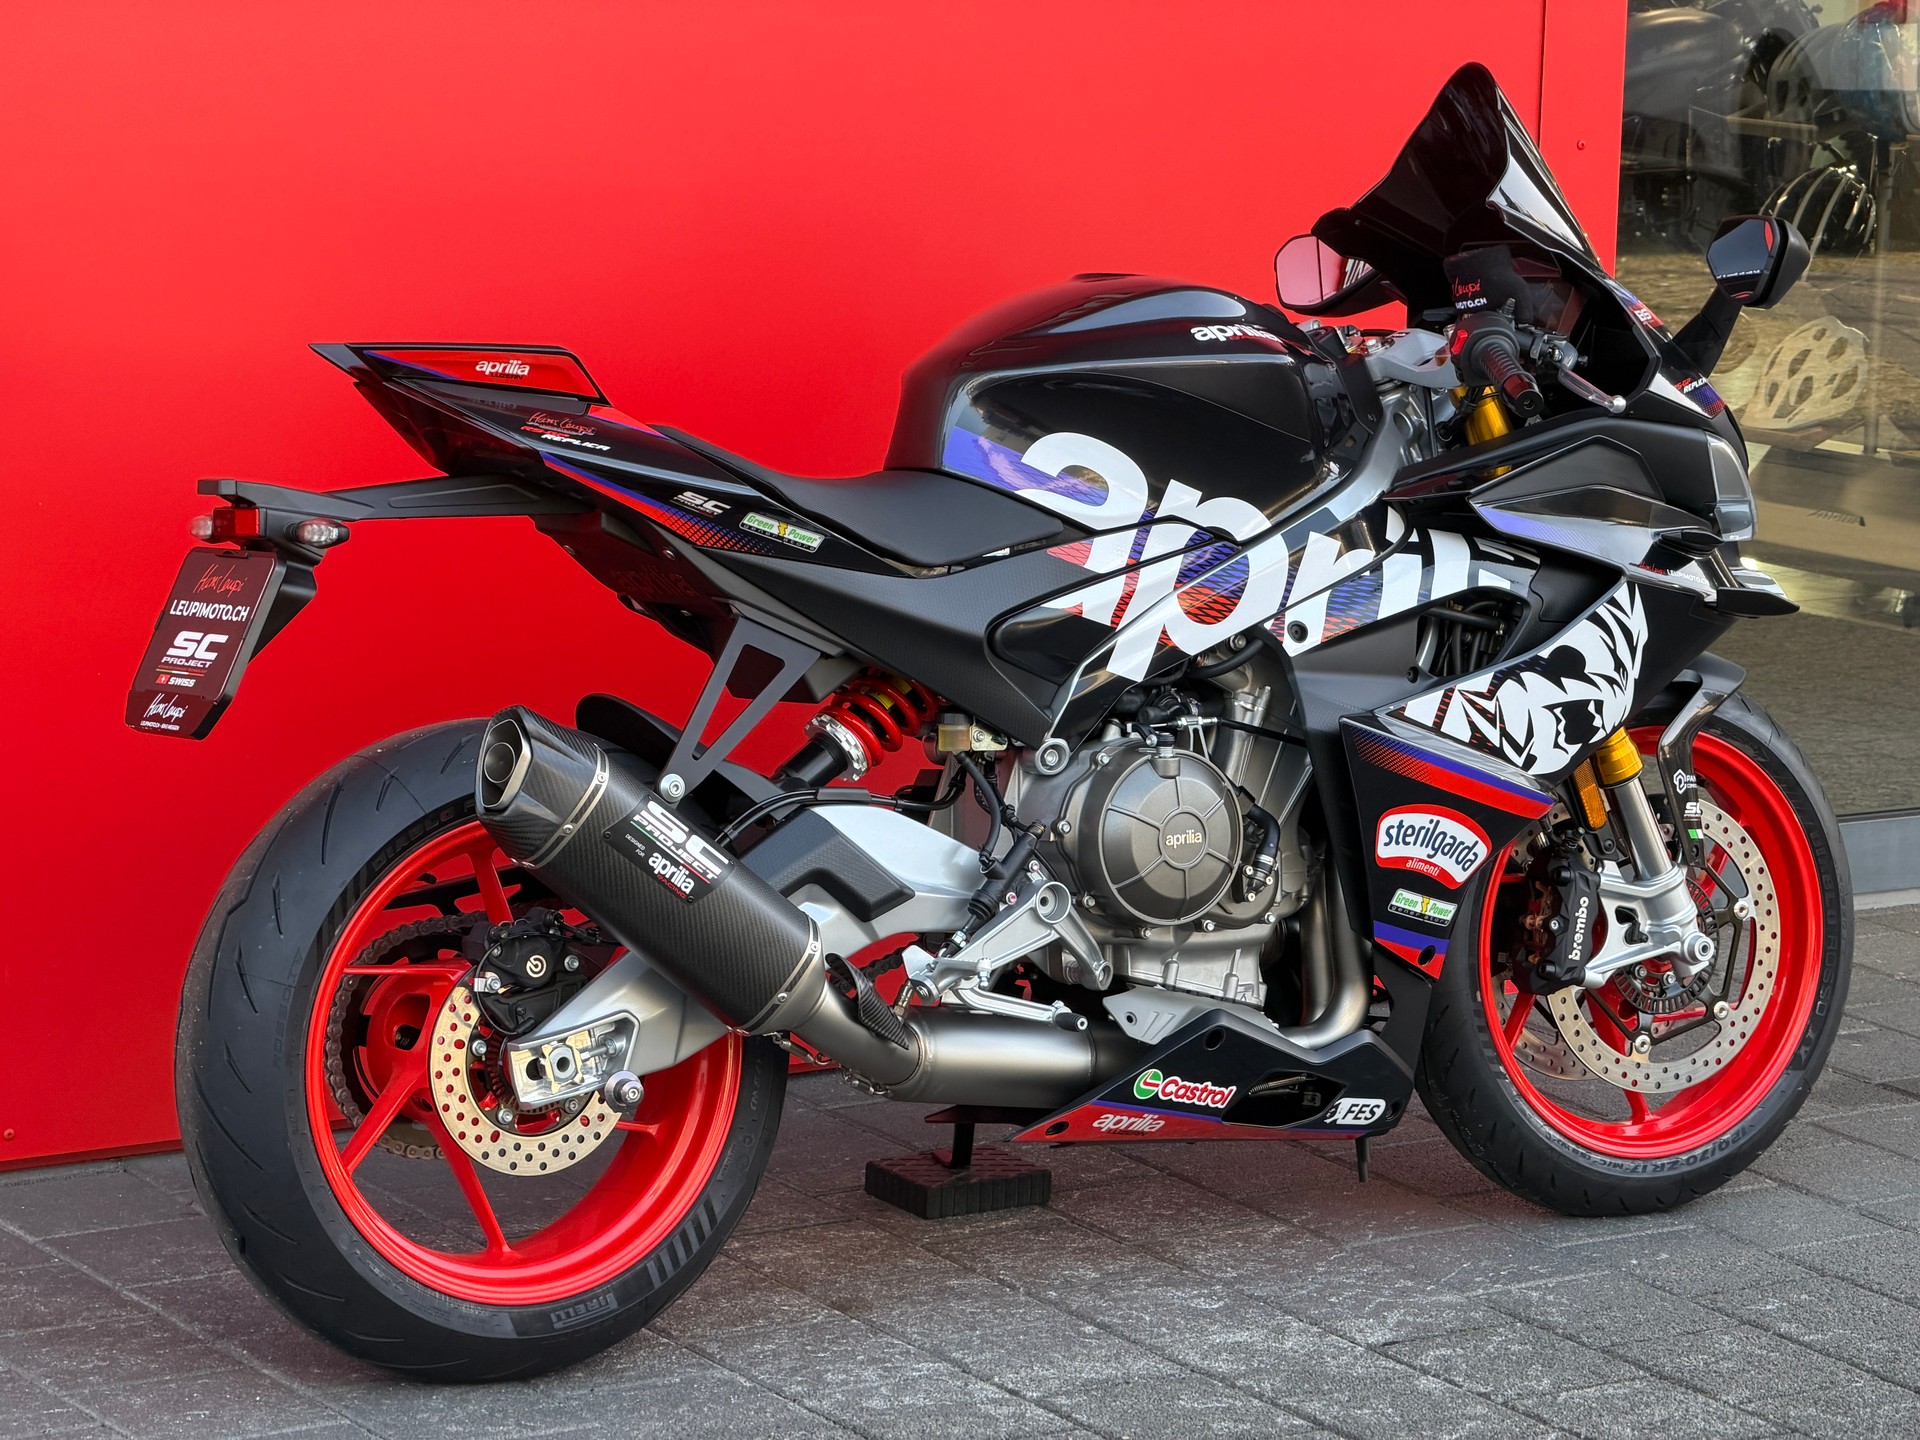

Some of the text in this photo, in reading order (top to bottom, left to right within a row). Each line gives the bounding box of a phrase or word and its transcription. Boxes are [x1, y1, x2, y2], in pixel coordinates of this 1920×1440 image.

[475, 359, 530, 376] aprilia
[541, 434, 611, 451] REPLICA
[676, 491, 731, 514] SC
[746, 514, 819, 545] Green Power
[169, 600, 251, 622] LEUPIMOTO.CH
[166, 631, 229, 661] SC
[161, 656, 212, 668] PROJECT
[167, 676, 196, 687] SWISS
[625, 833, 647, 851] DESIGNED
[632, 813, 718, 880] PROJECT
[640, 800, 730, 876] SC
[1165, 828, 1203, 850] aprilia
[1383, 818, 1479, 873] sterilgarda
[648, 852, 695, 895] aprilia
[1405, 857, 1441, 877] alimenti
[656, 873, 688, 899] RACING
[1394, 891, 1453, 918] Green Power
[1568, 896, 1589, 960] brembo
[1812, 934, 1841, 1019] ROSSO
[1161, 1076, 1234, 1107] Castrol
[1092, 1113, 1166, 1132] aprilia
[1341, 1103, 1382, 1121] FES
[549, 1291, 622, 1328] PIRELLI
